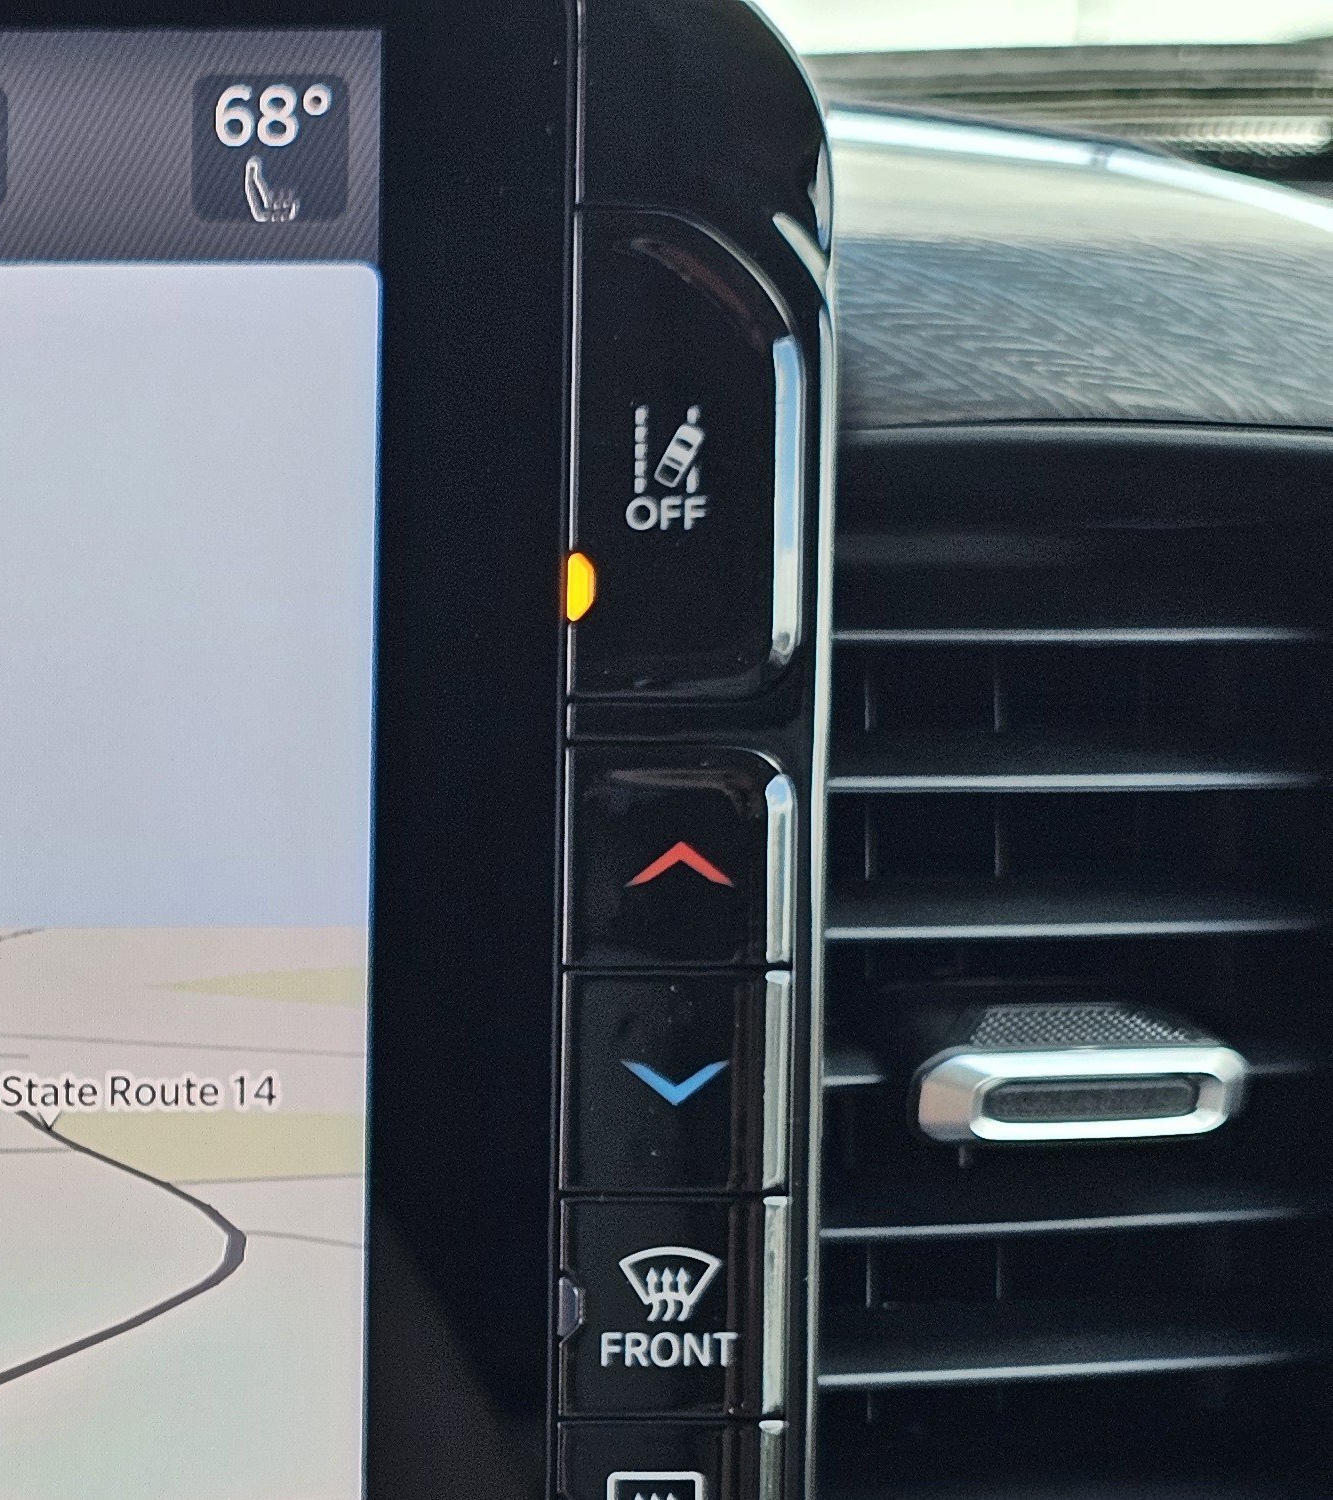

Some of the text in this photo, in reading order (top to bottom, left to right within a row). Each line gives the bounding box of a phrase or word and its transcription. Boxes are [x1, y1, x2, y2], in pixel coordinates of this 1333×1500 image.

[625, 495, 708, 531] OFF
[2, 1075, 98, 1107] State
[109, 1075, 219, 1107] Route
[234, 1076, 278, 1107] 14
[600, 1332, 738, 1368] FRONT
